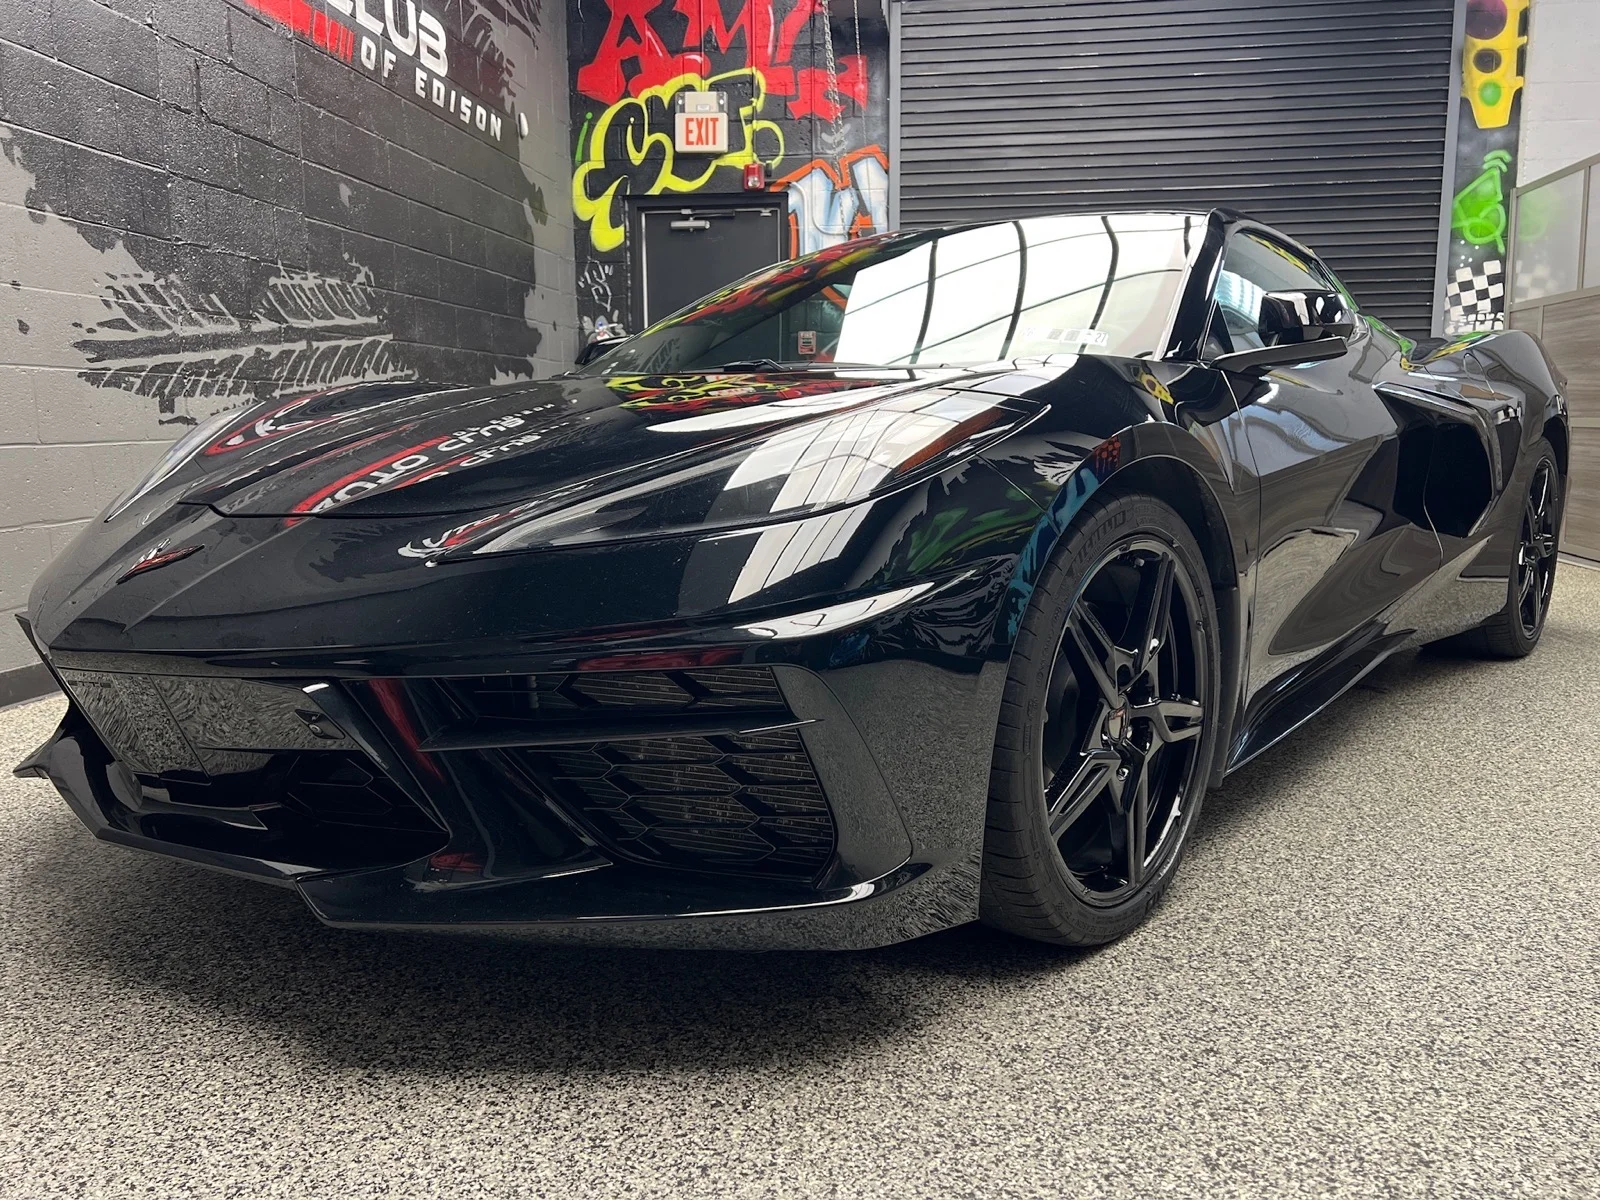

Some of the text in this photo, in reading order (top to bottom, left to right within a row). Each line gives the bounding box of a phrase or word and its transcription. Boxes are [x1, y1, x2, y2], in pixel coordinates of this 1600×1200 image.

[328, 0, 448, 77] LUB
[361, 36, 502, 141] OF EDISON
[685, 117, 719, 146] EXIT
